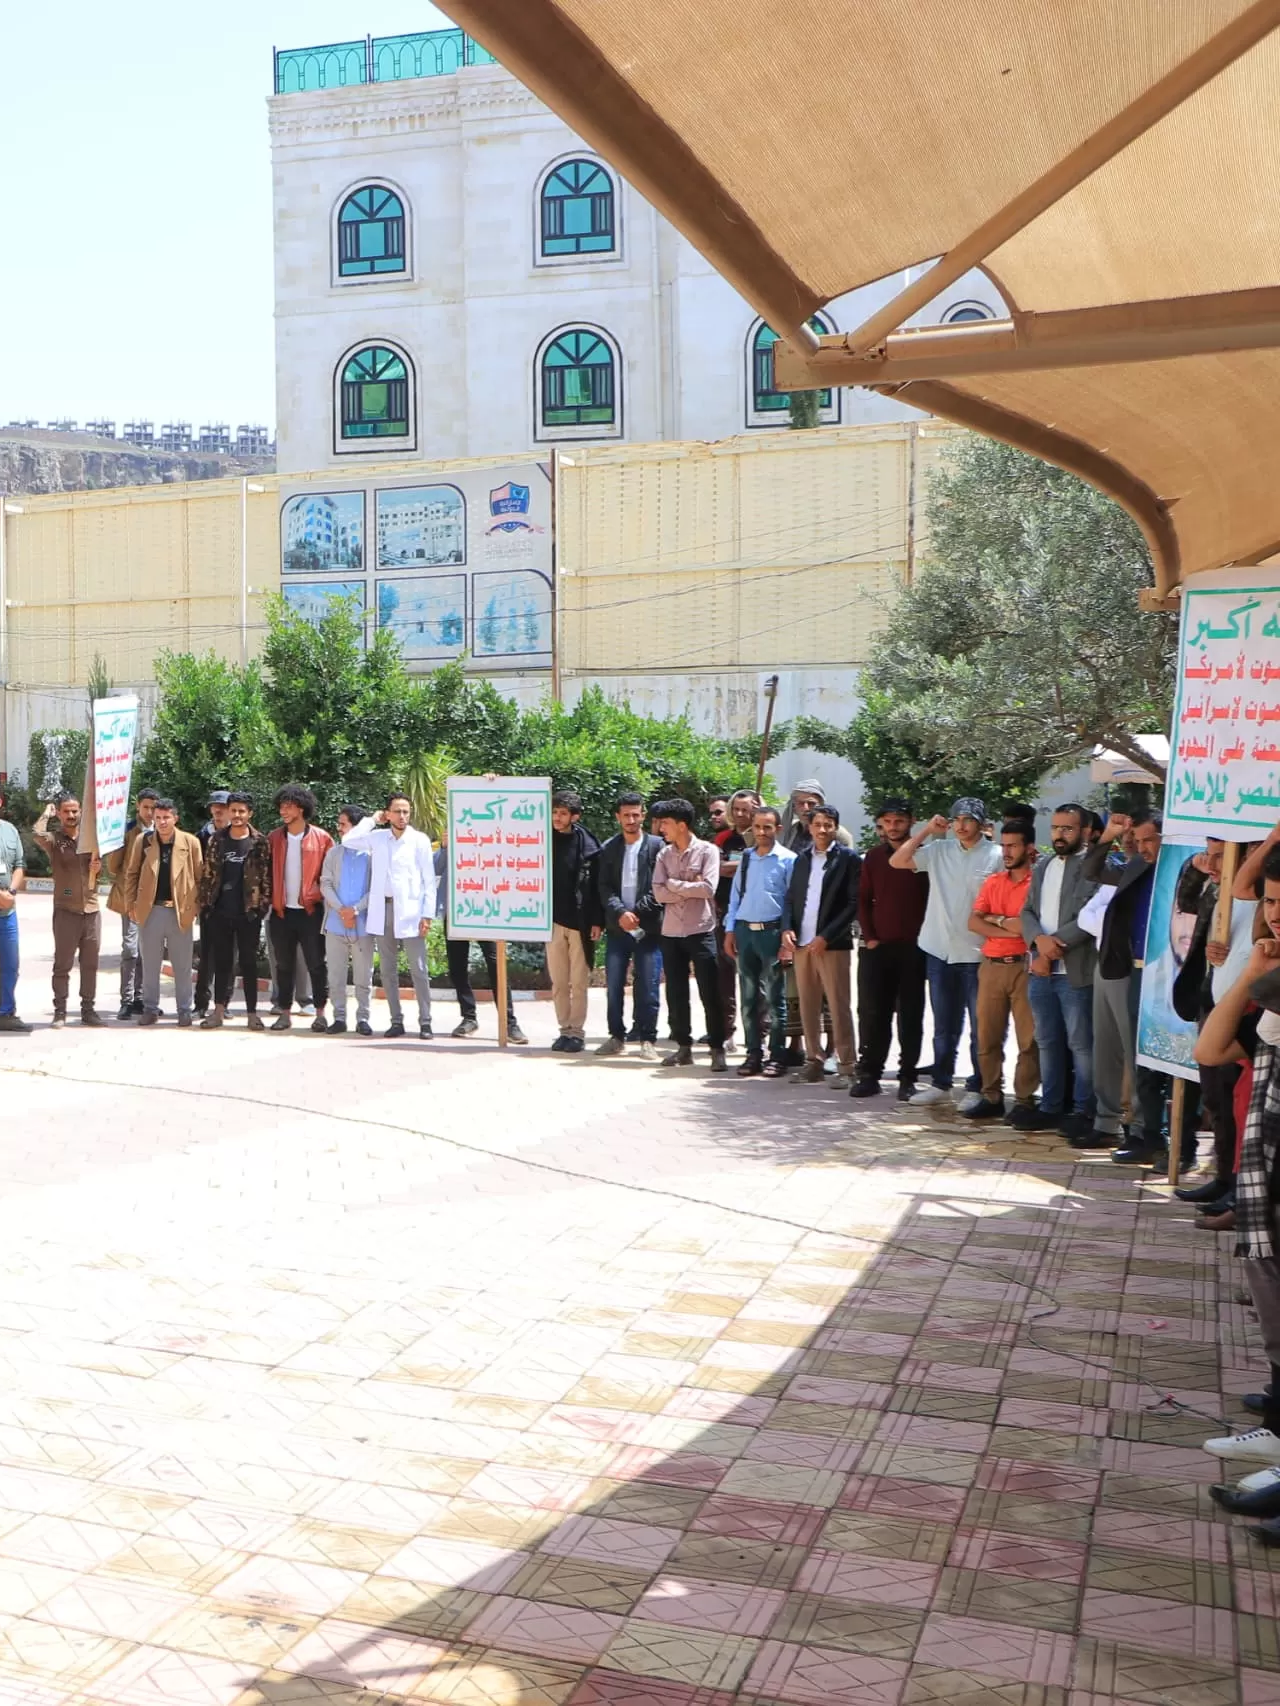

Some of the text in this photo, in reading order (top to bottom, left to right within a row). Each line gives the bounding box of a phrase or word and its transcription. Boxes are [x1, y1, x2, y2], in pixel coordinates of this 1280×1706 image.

[1187, 595, 1262, 651] أكبر
[1184, 648, 1246, 686] لأمريكا
[1180, 692, 1242, 727] لإسرائيل
[1178, 732, 1215, 765] اليهود
[1218, 735, 1246, 766] على
[1173, 769, 1229, 814] للإسلام
[456, 795, 545, 826] الله أكبر
[455, 826, 545, 848] الموت لأمريكا
[455, 852, 545, 873] الموت لإسرائيل
[455, 875, 545, 895] اللعنة على اليهود
[456, 896, 545, 924] النصر للإسلام
